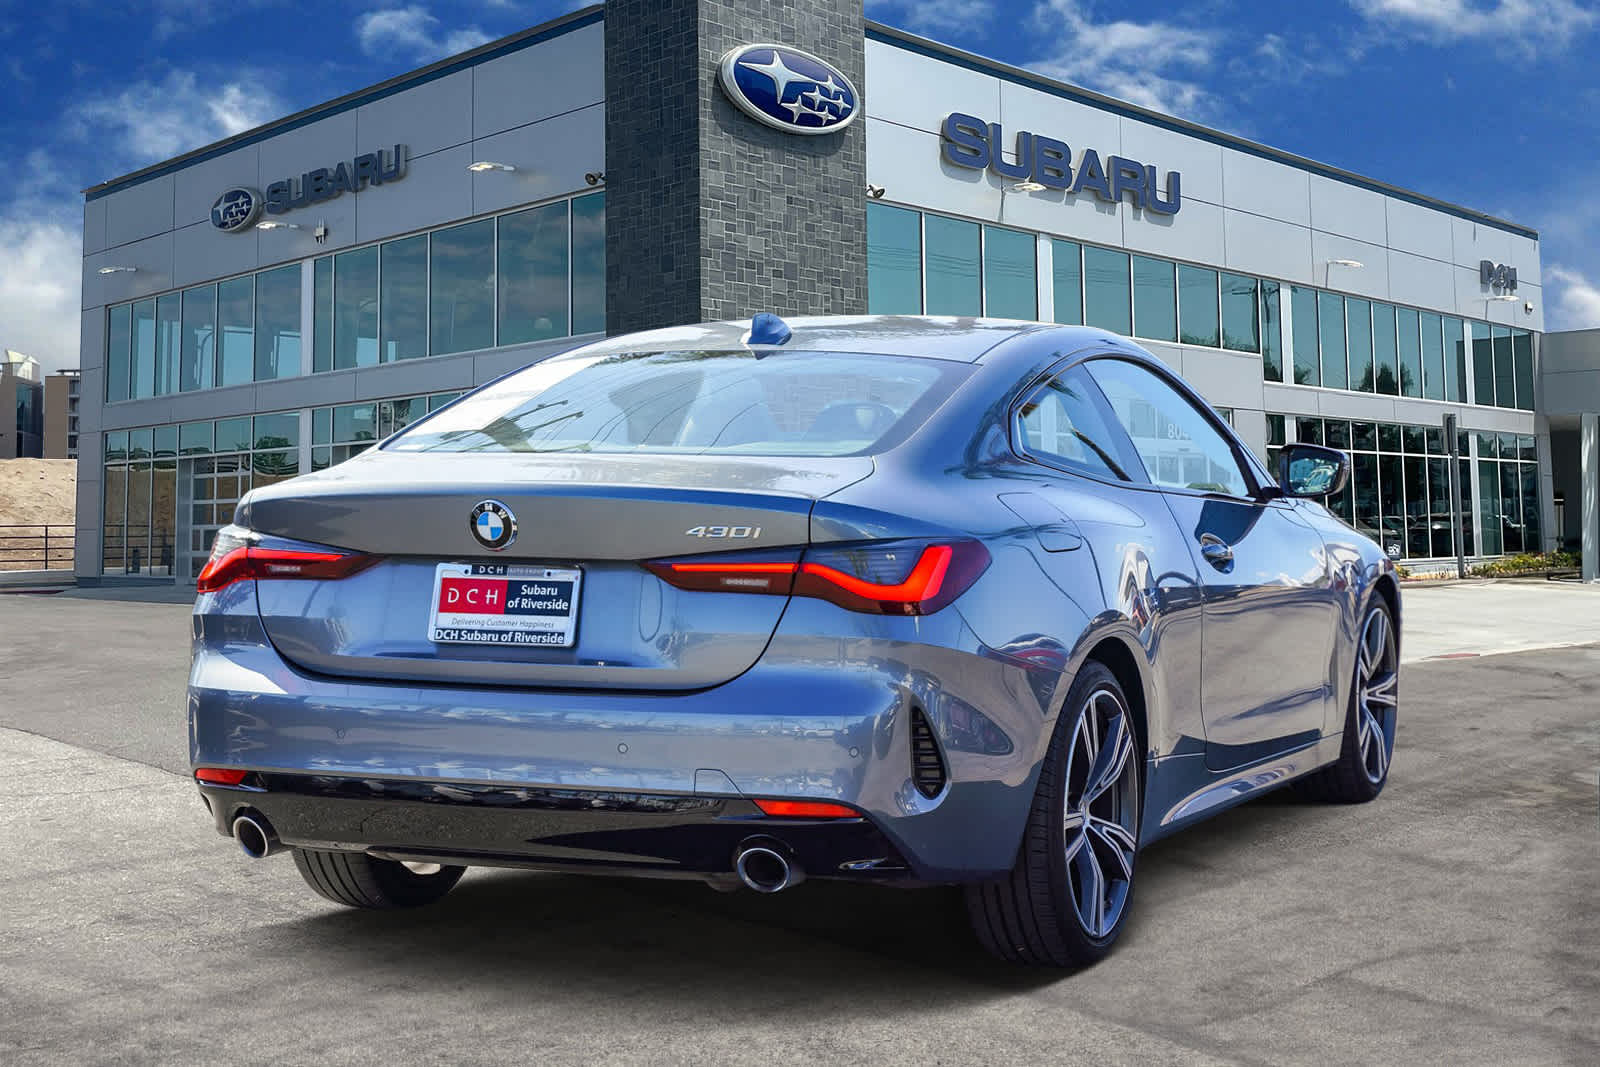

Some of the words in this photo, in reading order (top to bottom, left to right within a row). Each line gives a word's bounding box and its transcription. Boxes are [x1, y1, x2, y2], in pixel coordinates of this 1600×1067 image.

[941, 112, 1181, 214] SUBARU
[266, 144, 407, 214] SUBARU
[479, 566, 504, 574] DCH
[521, 585, 558, 596] Subaru
[507, 598, 520, 609] of
[521, 598, 569, 610] Riverside
[451, 617, 485, 627] Delivering
[486, 618, 518, 627] Customer
[519, 620, 554, 629] Happiness
[434, 629, 459, 640] DCH
[460, 630, 499, 642] Subaru
[500, 631, 513, 642] of
[514, 632, 564, 644] Riverside
